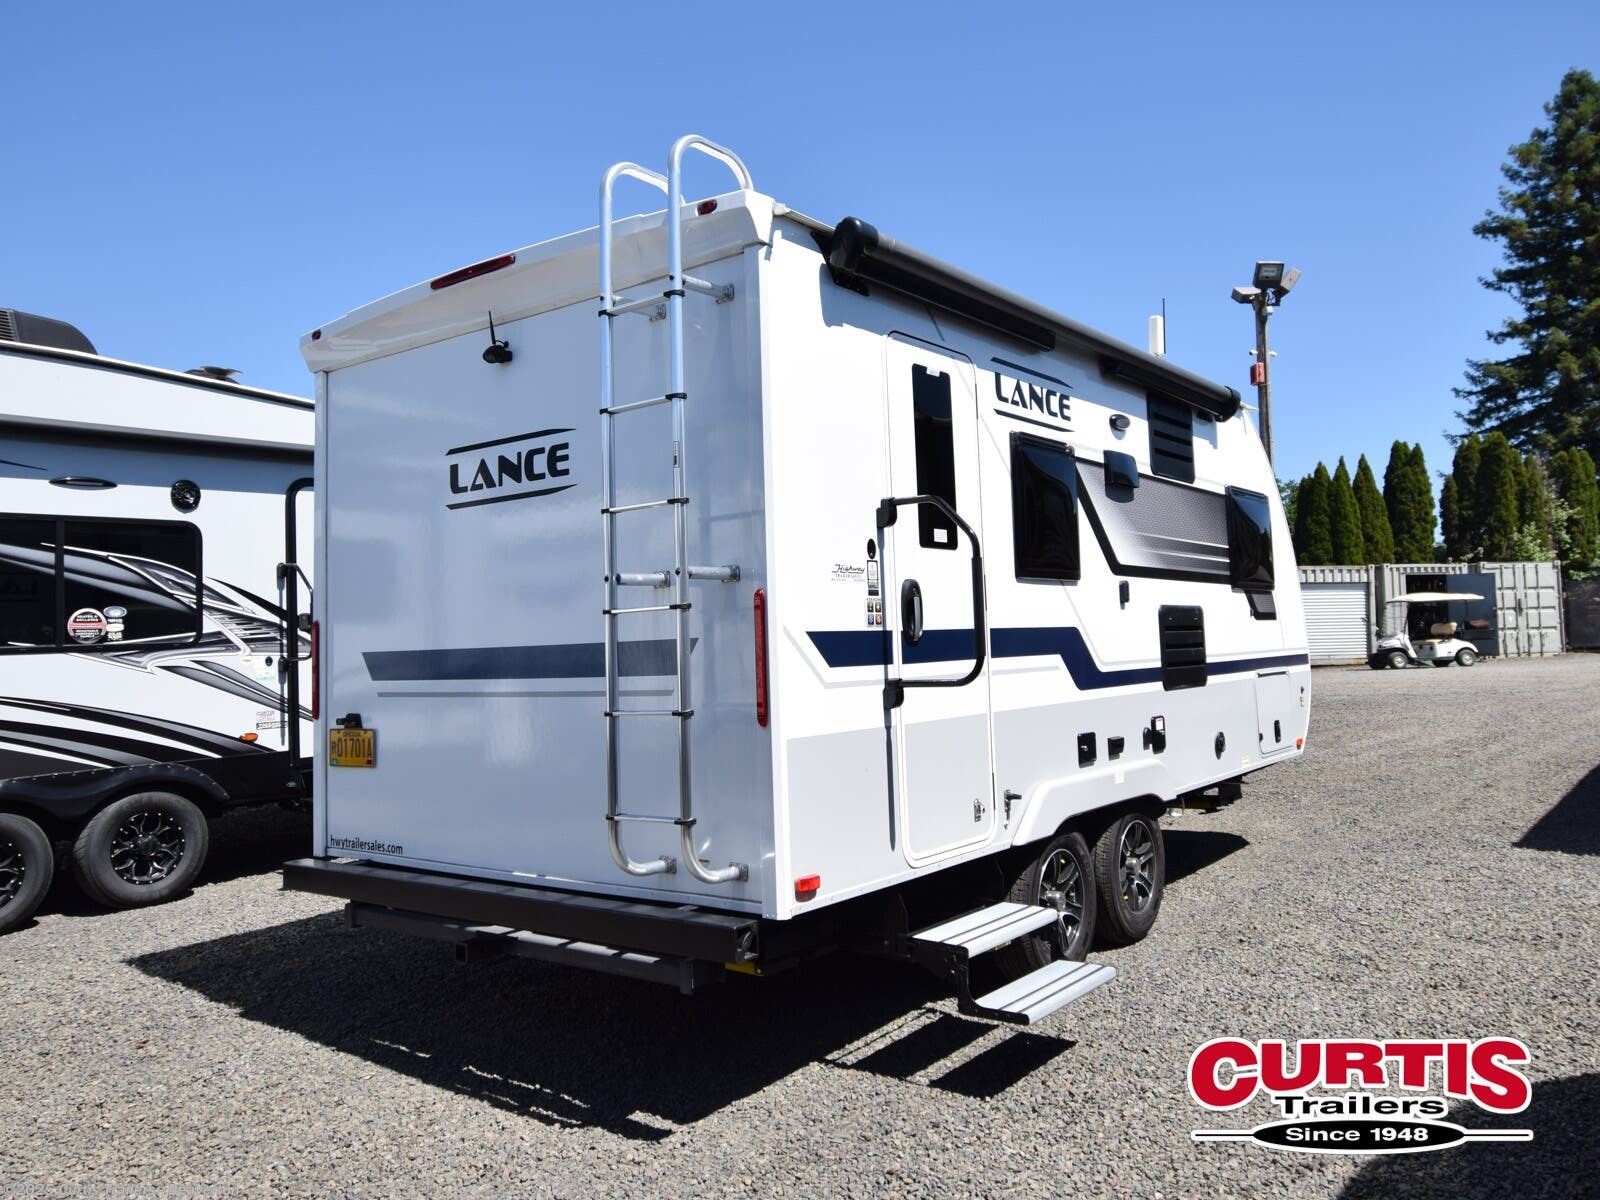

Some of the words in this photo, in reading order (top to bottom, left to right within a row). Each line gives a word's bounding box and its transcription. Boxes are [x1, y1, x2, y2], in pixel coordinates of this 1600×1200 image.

[995, 371, 1071, 422] LANCE
[449, 442, 570, 494] LANCE
[330, 835, 403, 854] hwytrailersales.com
